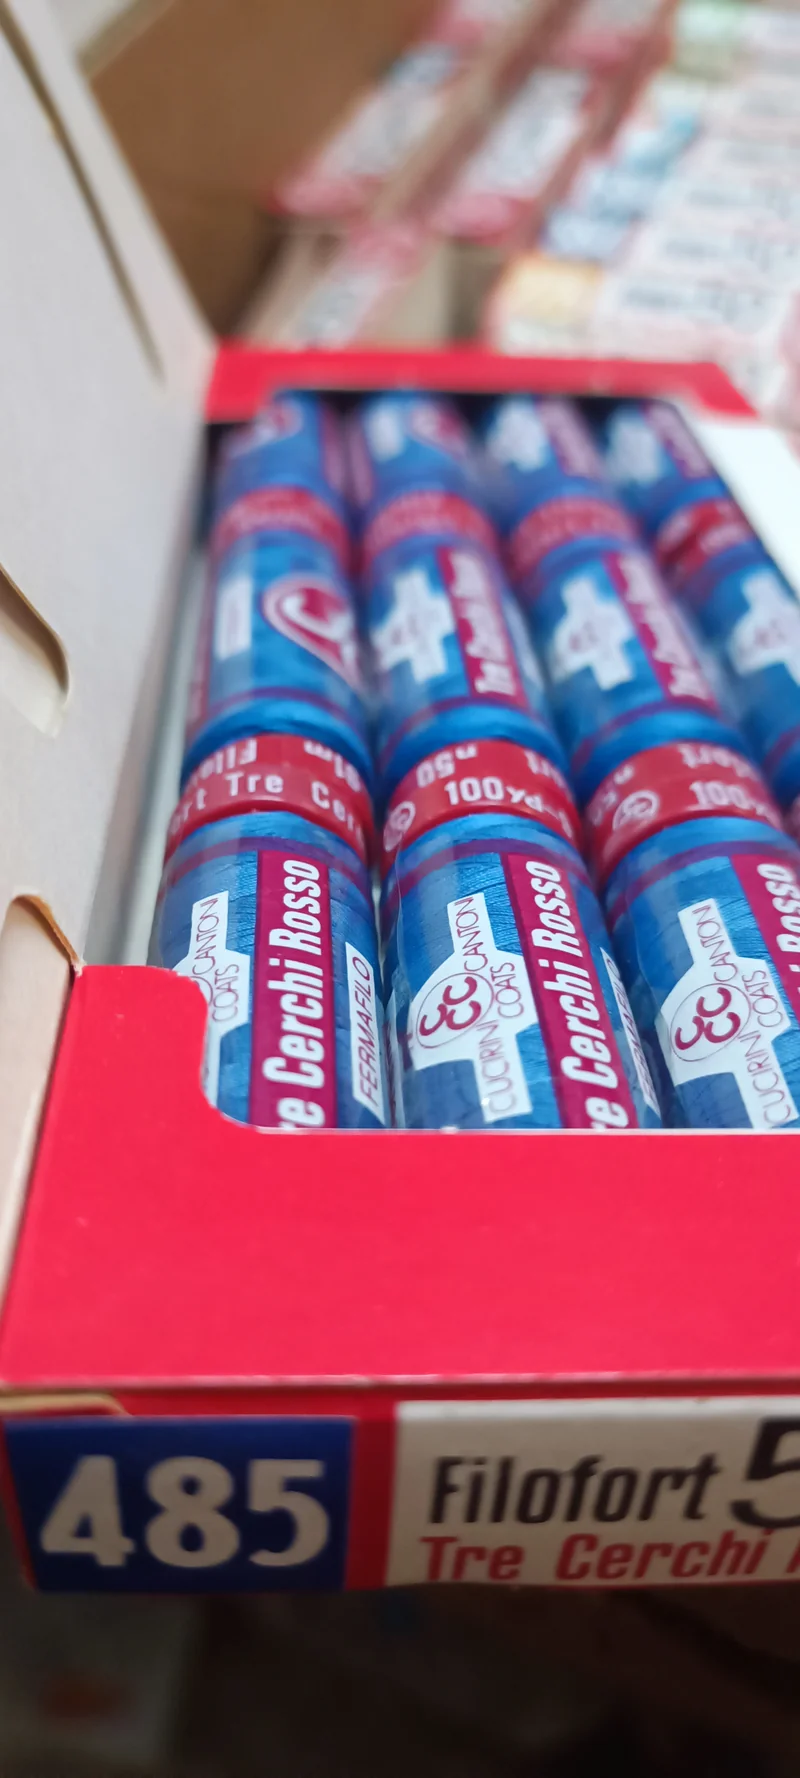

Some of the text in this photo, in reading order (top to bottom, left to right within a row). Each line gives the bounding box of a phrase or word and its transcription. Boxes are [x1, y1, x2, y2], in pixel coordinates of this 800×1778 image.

[224, 771, 284, 797] Tre
[268, 859, 322, 956] Rosso
[525, 860, 584, 958] Rosso
[211, 963, 240, 1022] COATS
[262, 957, 325, 1089] Cerchi
[351, 956, 381, 1106] FERMAFILO
[489, 962, 525, 1019] COATS
[543, 958, 618, 1089] Cerchi
[692, 904, 792, 1128] CUCIRINI CANTONI
[741, 970, 784, 1028] COATS
[40, 1455, 330, 1568] 485
[428, 1453, 721, 1524] Filofort
[419, 1535, 525, 1582] Tre
[555, 1529, 774, 1581] Cerchi
